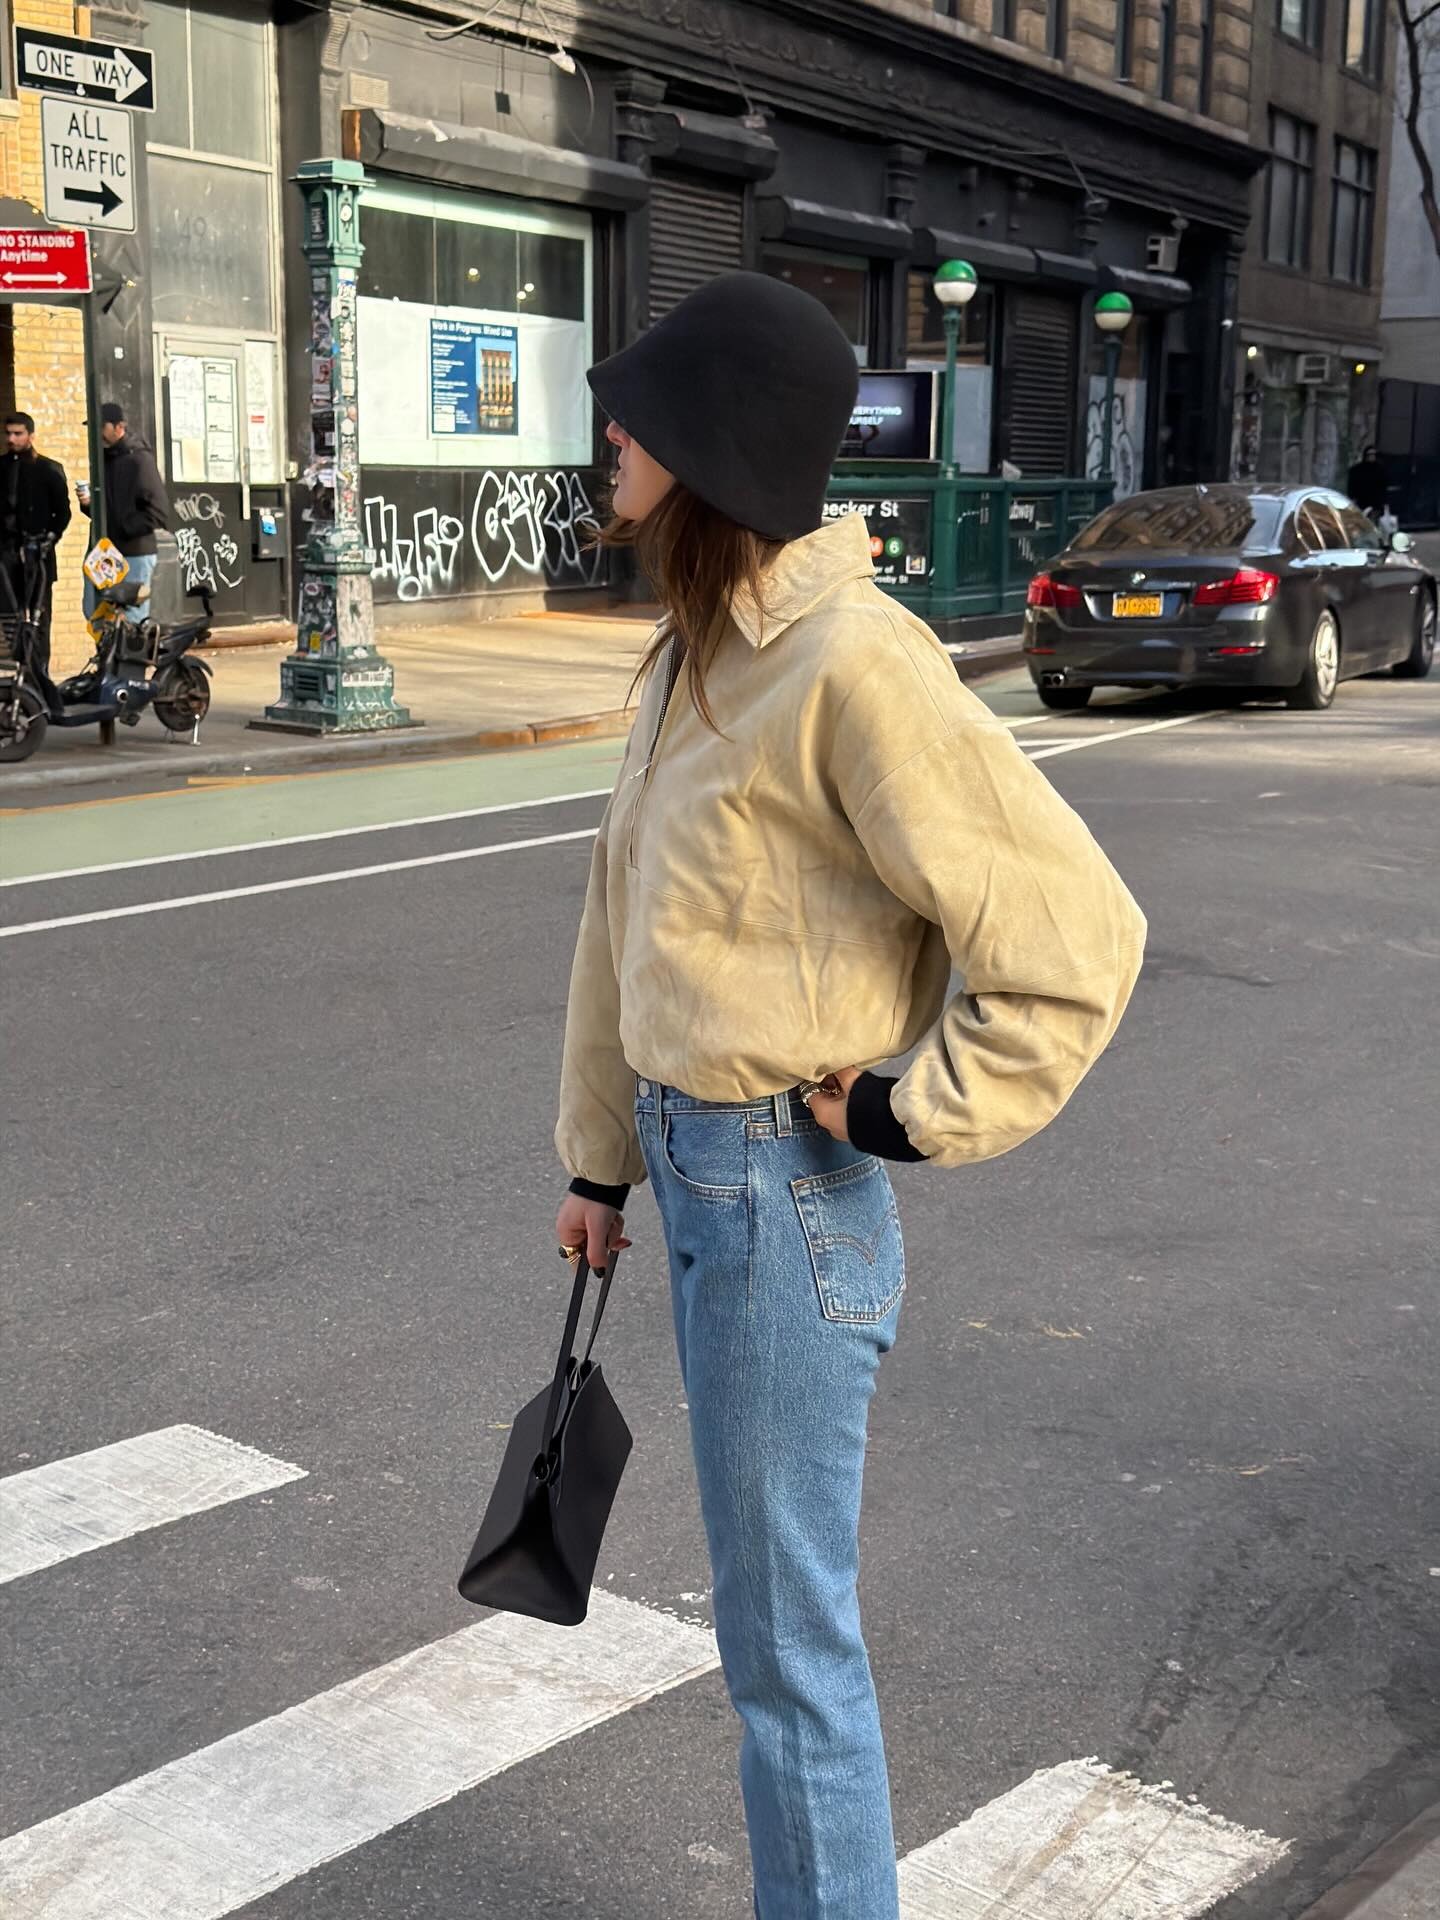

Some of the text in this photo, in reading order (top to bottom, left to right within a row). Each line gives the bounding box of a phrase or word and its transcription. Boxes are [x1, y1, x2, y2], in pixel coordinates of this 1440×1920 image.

[36, 50, 75, 77] ONE
[92, 60, 132, 88] WAY
[67, 110, 108, 141] ALL
[50, 143, 126, 177] TRAFFIC
[0, 234, 75, 248] NO STANDING
[1, 249, 48, 264] Anytime
[880, 500, 899, 517] St
[890, 541, 900, 553] 6
